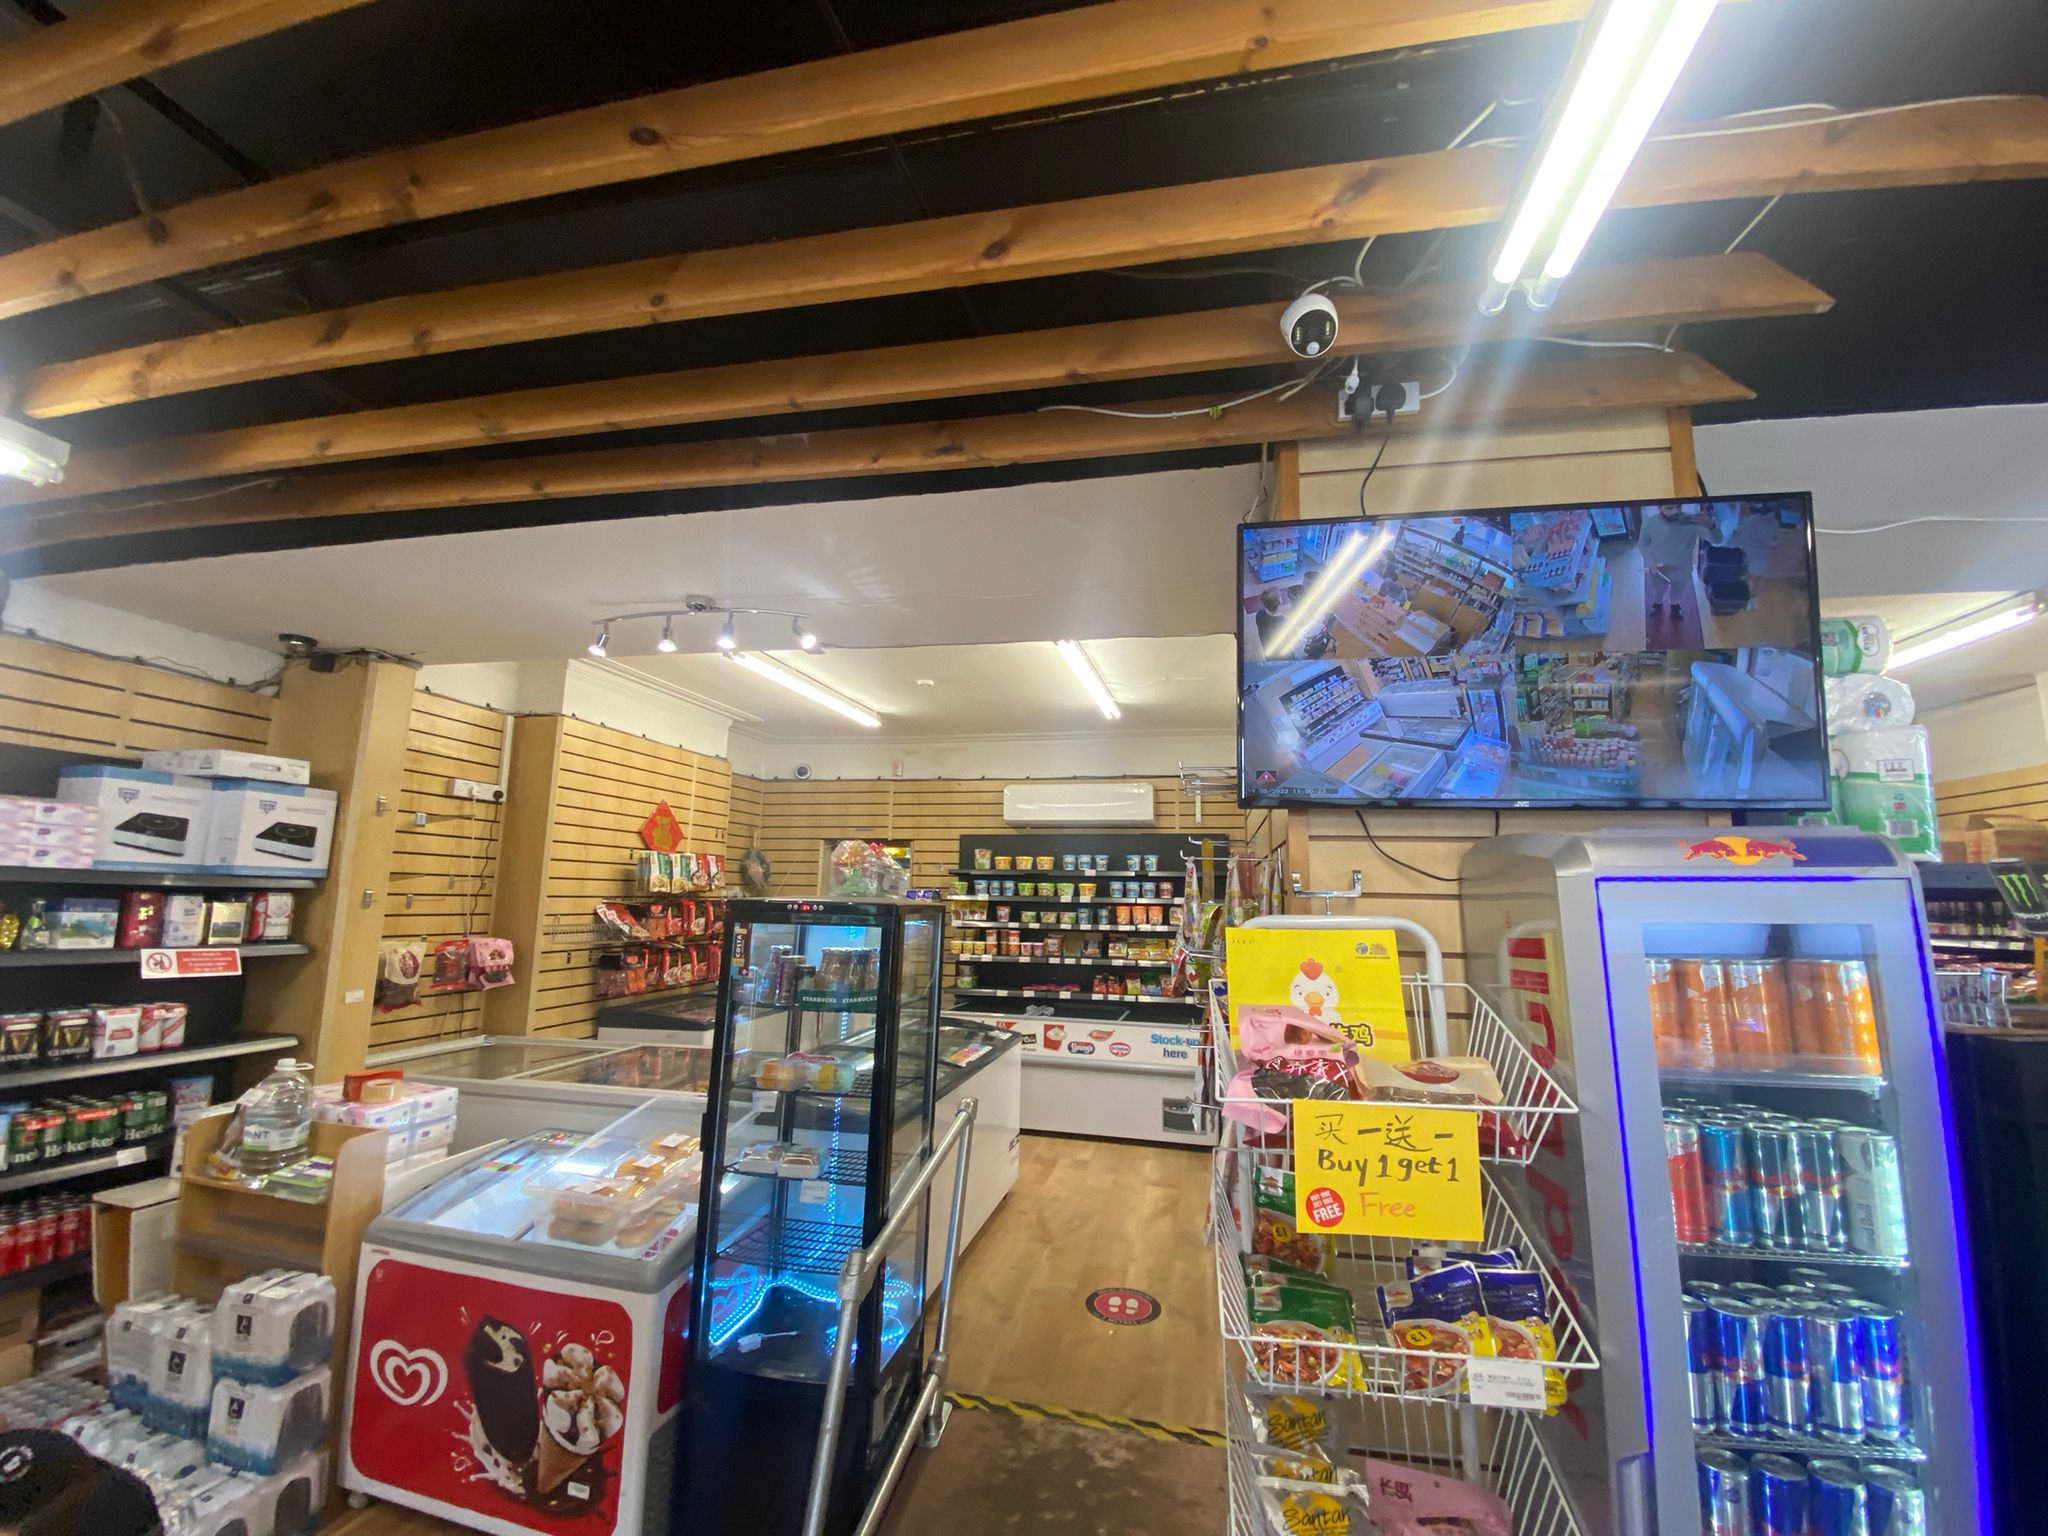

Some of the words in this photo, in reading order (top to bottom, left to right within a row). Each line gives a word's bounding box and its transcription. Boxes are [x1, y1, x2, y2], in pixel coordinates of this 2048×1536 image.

[1514, 800, 1530, 808] JVC
[734, 934, 743, 958] COSTA
[802, 995, 838, 1004] STARBUCKS
[842, 995, 878, 1004] STARBUCKS
[1163, 1048, 1188, 1060] here
[1315, 1113, 1454, 1152] 买一送一
[1318, 1148, 1368, 1187] Buy
[1376, 1154, 1392, 1178] 1
[1397, 1156, 1443, 1182] get
[1447, 1157, 1460, 1182] 1
[1358, 1191, 1417, 1218] Free
[1313, 1203, 1343, 1223] FREE
[1274, 1226, 1289, 1238] £1
[1409, 1330, 1428, 1344] £1
